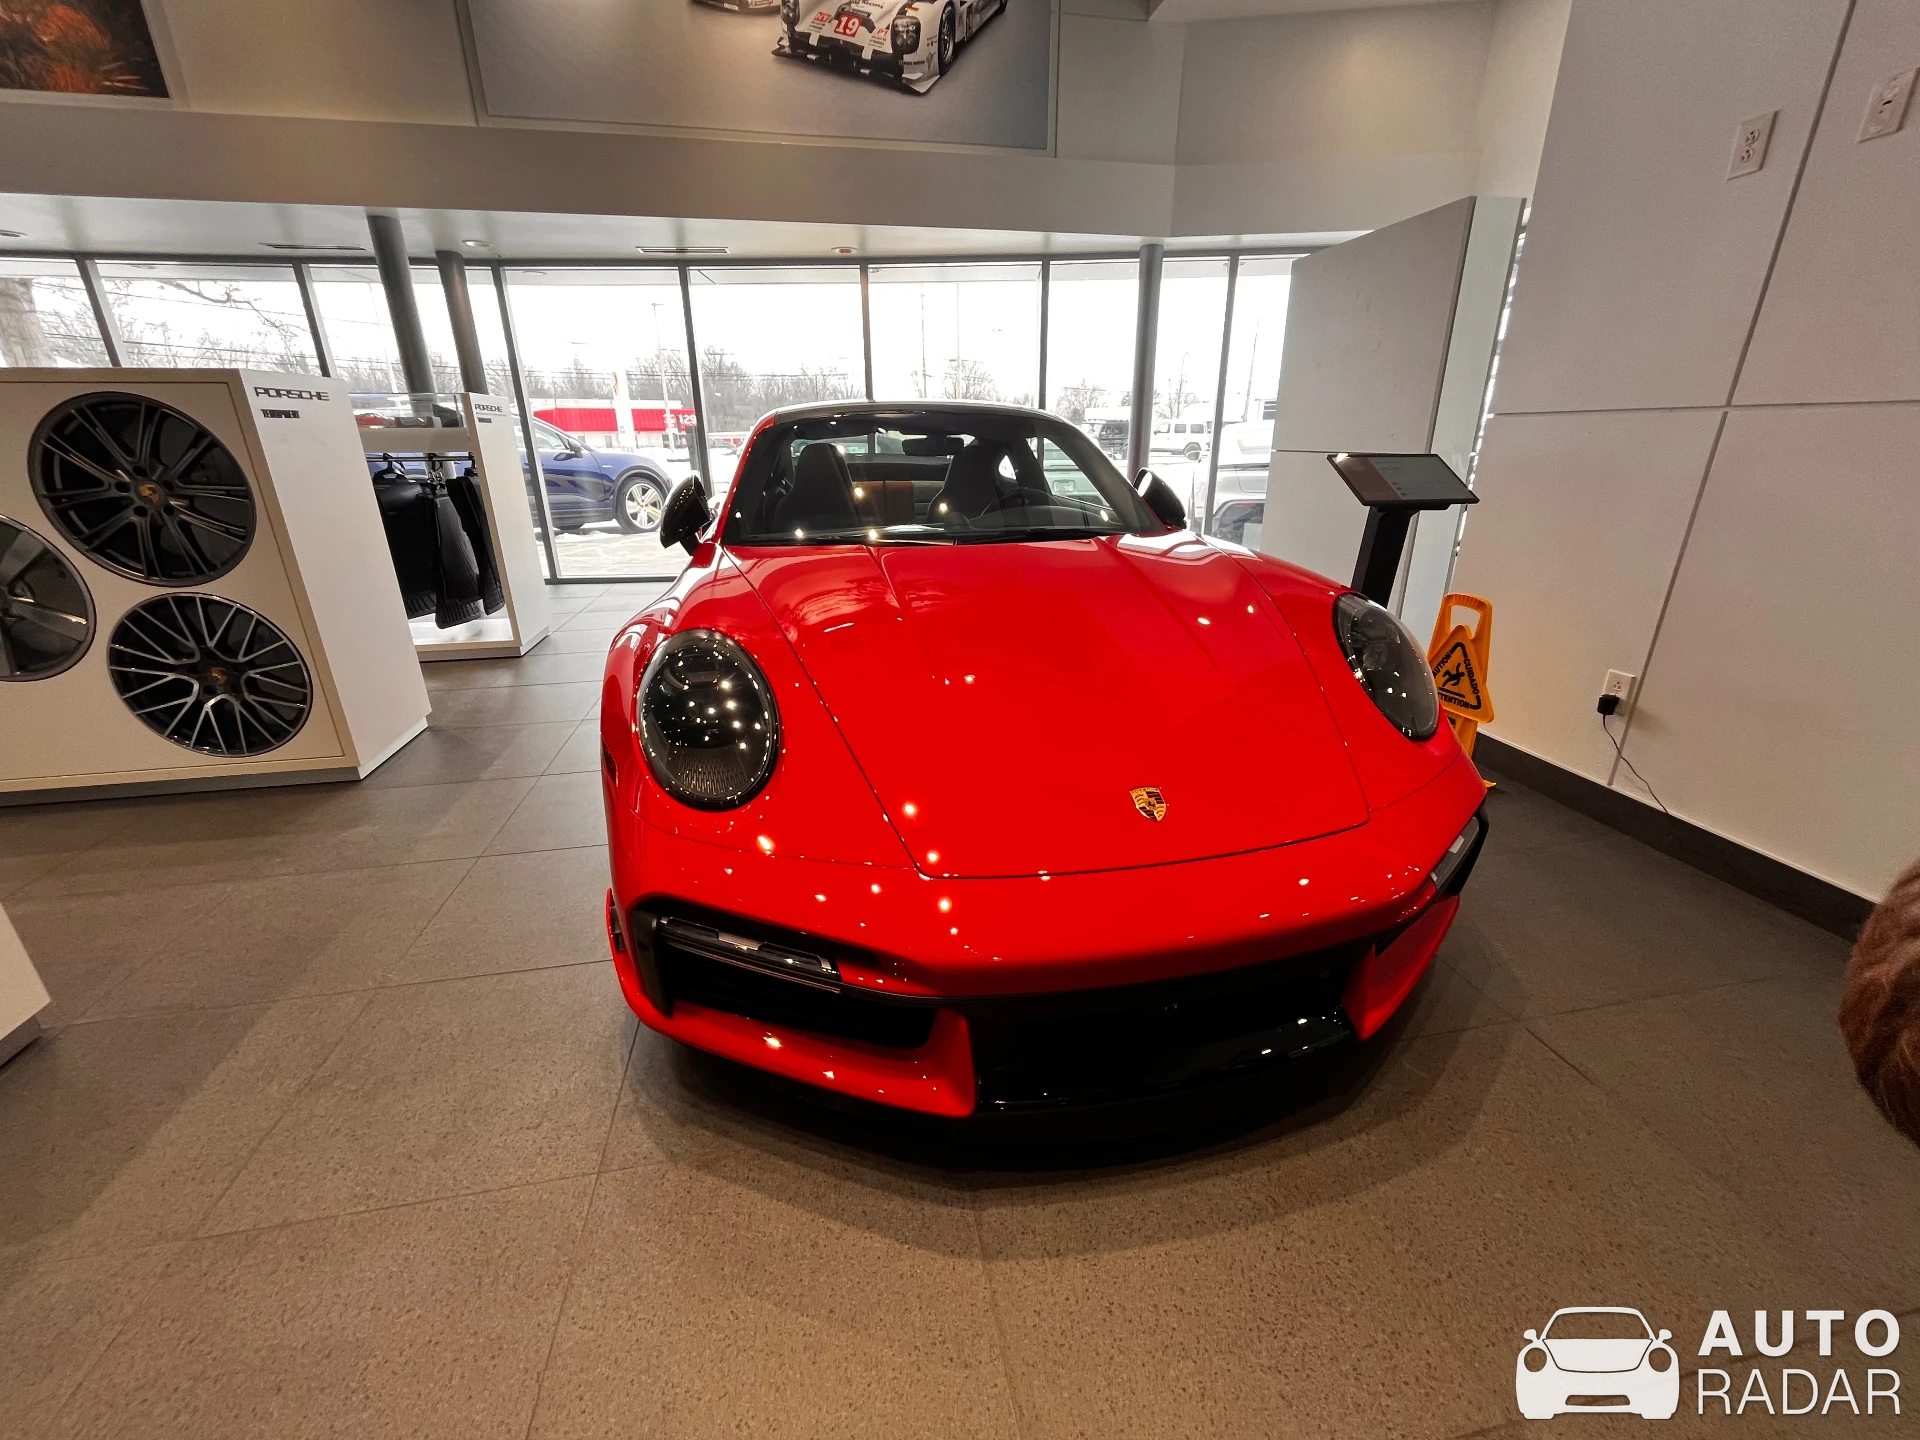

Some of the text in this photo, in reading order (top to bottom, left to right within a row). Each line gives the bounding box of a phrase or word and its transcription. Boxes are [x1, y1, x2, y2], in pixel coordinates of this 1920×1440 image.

[835, 16, 860, 35] 19
[253, 387, 330, 401] PORSCHE
[1432, 653, 1452, 678] AUTION
[1463, 657, 1480, 695] CUIDADO
[1438, 691, 1470, 709] TENTION
